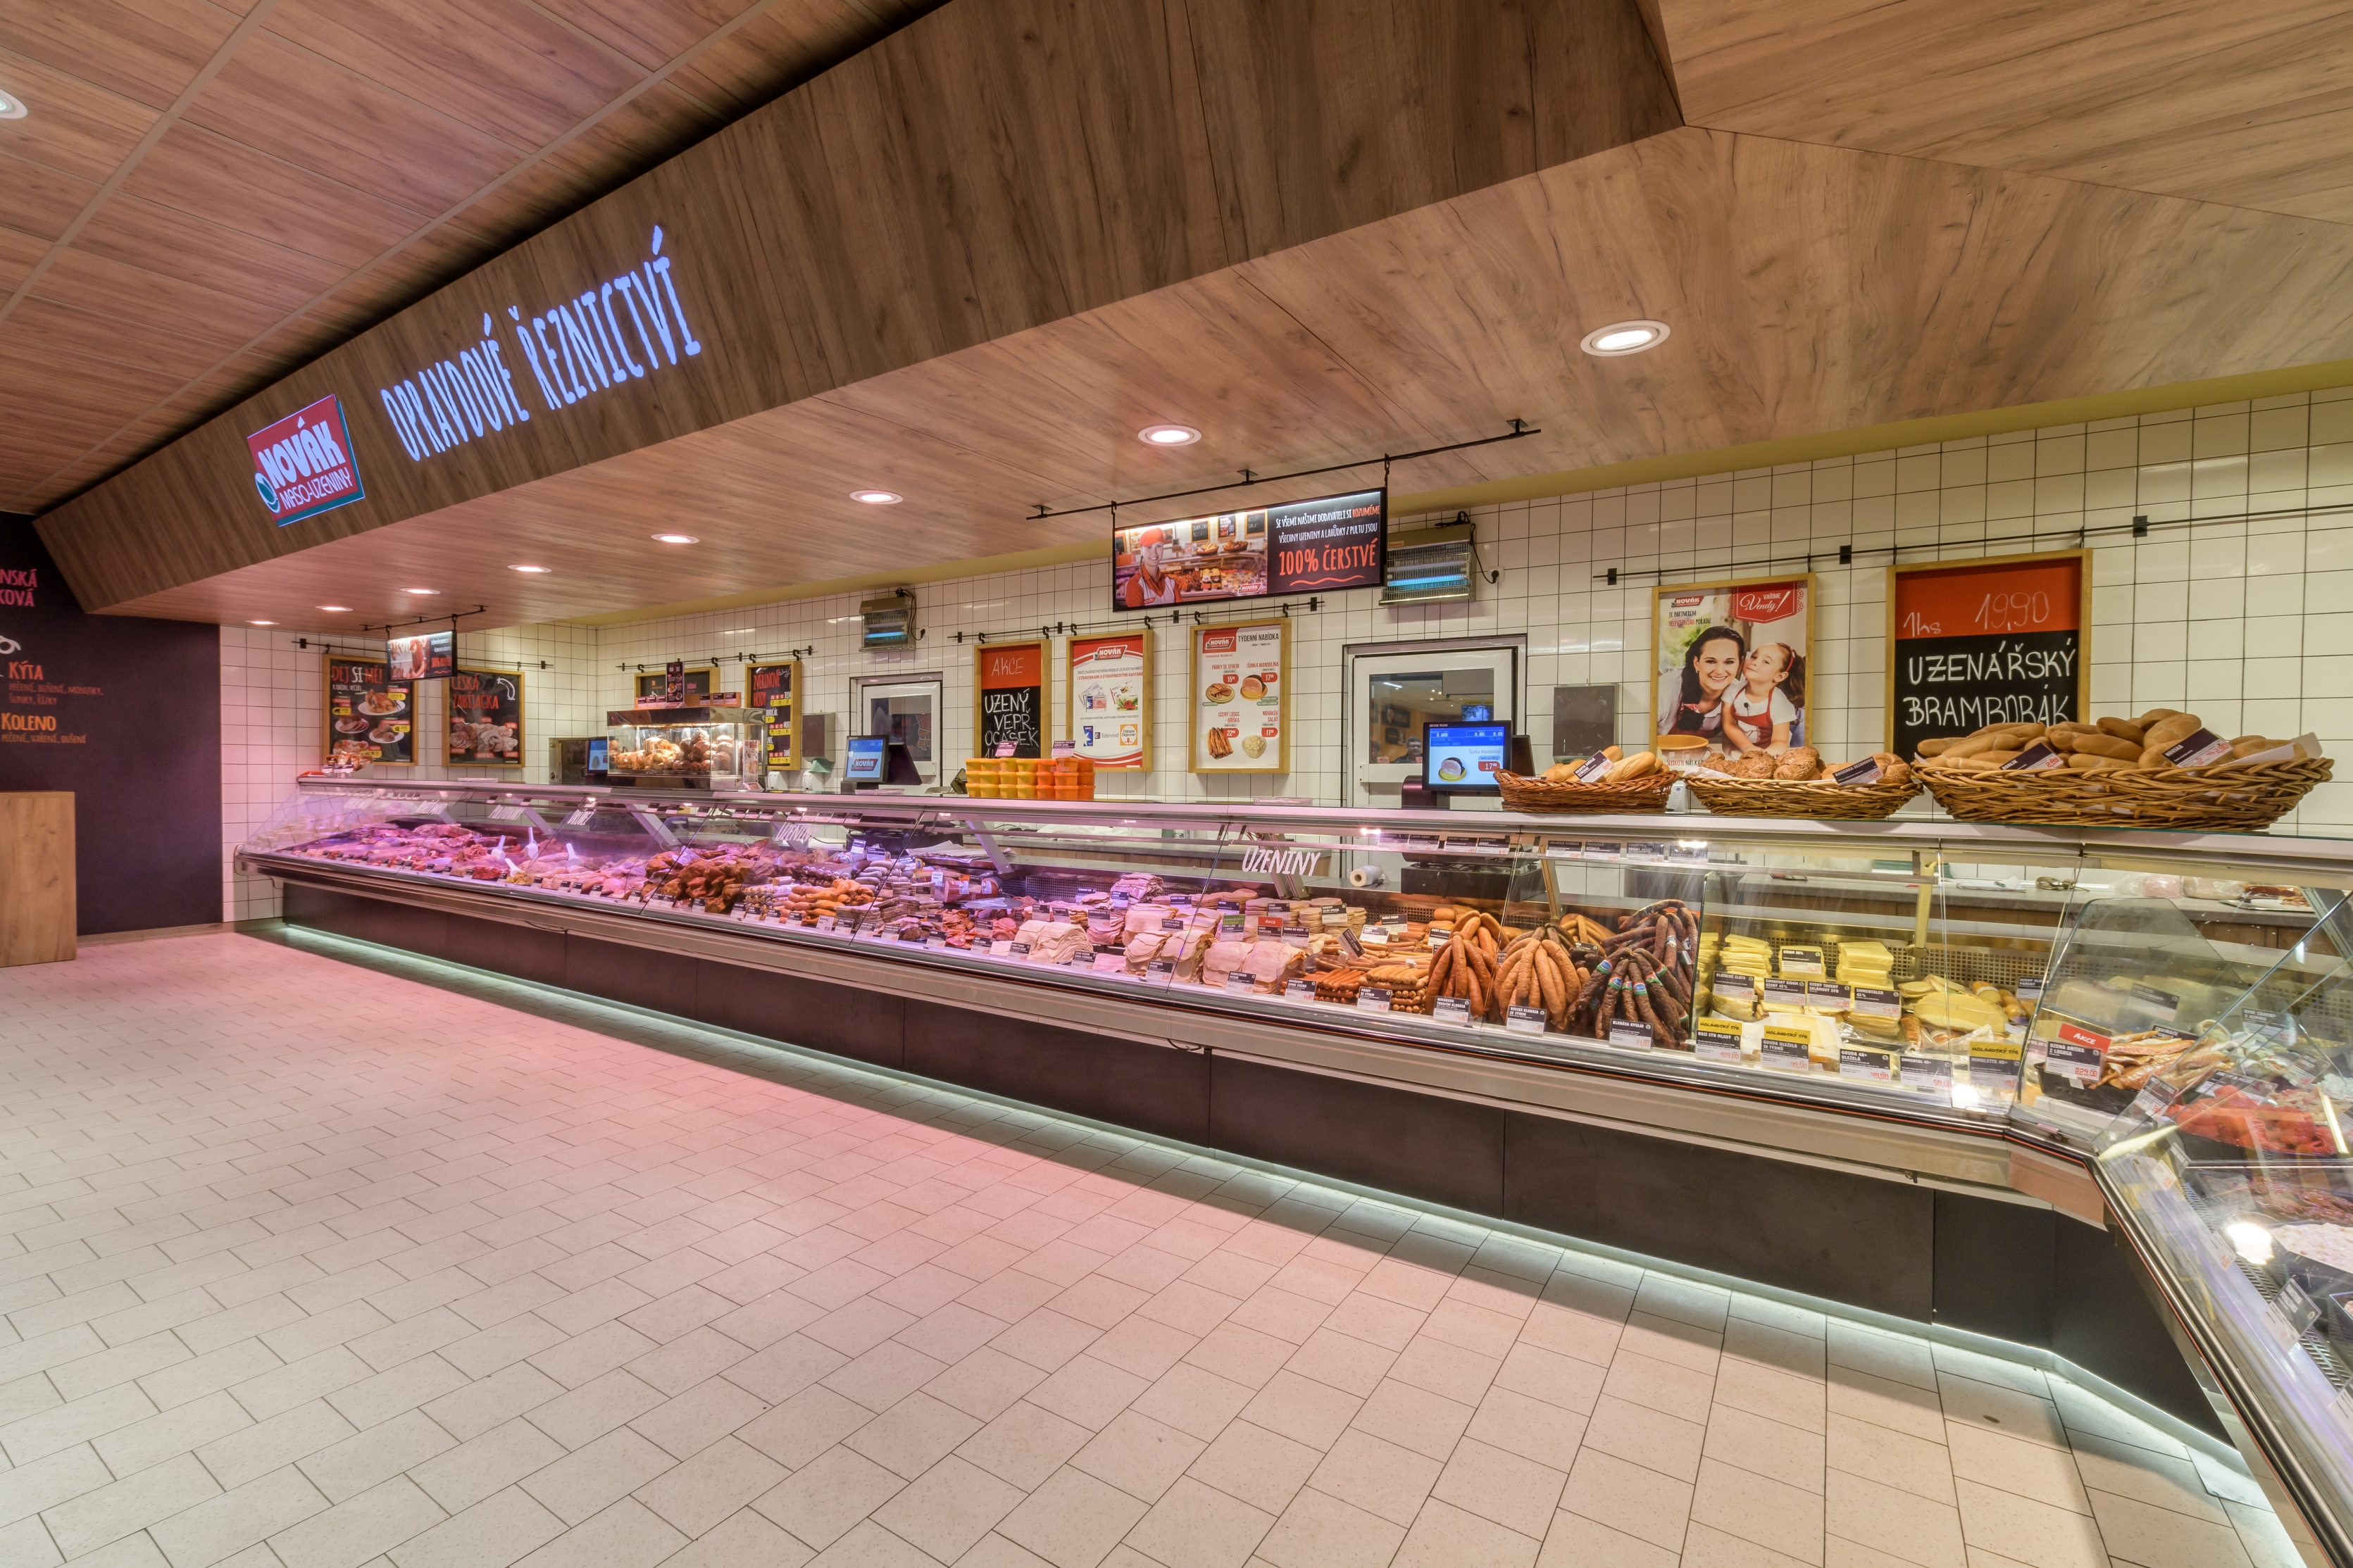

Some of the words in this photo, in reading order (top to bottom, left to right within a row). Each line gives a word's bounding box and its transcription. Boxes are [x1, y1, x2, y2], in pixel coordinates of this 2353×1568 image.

[380, 312, 530, 462] OPRAVDOVÉ
[508, 225, 701, 410] ŘEZNICTVÍ
[258, 415, 346, 489] NOVÁK
[279, 467, 353, 510] MASO-UZENINY
[1282, 515, 1297, 527] VŠEMI
[1297, 513, 1317, 525] NAŠIMI
[1317, 509, 1346, 522] DODAVATELI
[1346, 509, 1352, 518] SI
[1352, 504, 1380, 518] ROZUMÍME
[1278, 532, 1299, 544] VŠECHNY
[1299, 530, 1321, 541] UZENINY
[1321, 529, 1325, 538] A
[1325, 524, 1346, 537] LAHŮDKY
[1346, 527, 1349, 535] Z
[1349, 525, 1365, 535] PULTU
[1365, 522, 1378, 534] JSOU
[1278, 548, 1319, 576] 100%
[1323, 537, 1378, 571] ČERSTVÉ
[1974, 591, 2050, 631] 19,90
[1238, 633, 1258, 642] TÝDENNÍ
[1258, 632, 1279, 641] NABÍDKA
[1099, 647, 1121, 656] NOVÁK
[1909, 637, 2076, 685] UZENÁŘSKÝ
[9, 660, 44, 680] KÝTA
[332, 665, 350, 684] DEJ
[351, 666, 363, 683] SI
[365, 665, 382, 684] MĚ!
[991, 658, 1024, 677] AKCE
[452, 691, 499, 710] ZABÍJAČKA
[753, 691, 767, 707] HODY
[985, 688, 1030, 714] UZENÝ
[1902, 684, 2069, 728] BRAMBORÁK
[1, 713, 56, 731] KOLENO
[2164, 744, 2184, 757] HOUSKA
[1834, 767, 1854, 777] KAISERKA
[1853, 758, 1874, 769] SEZAMOVÁ
[2001, 759, 2018, 770] ROHLÍK
[1242, 845, 1321, 877] UZENINY
[2073, 1032, 2097, 1045] AKCE
